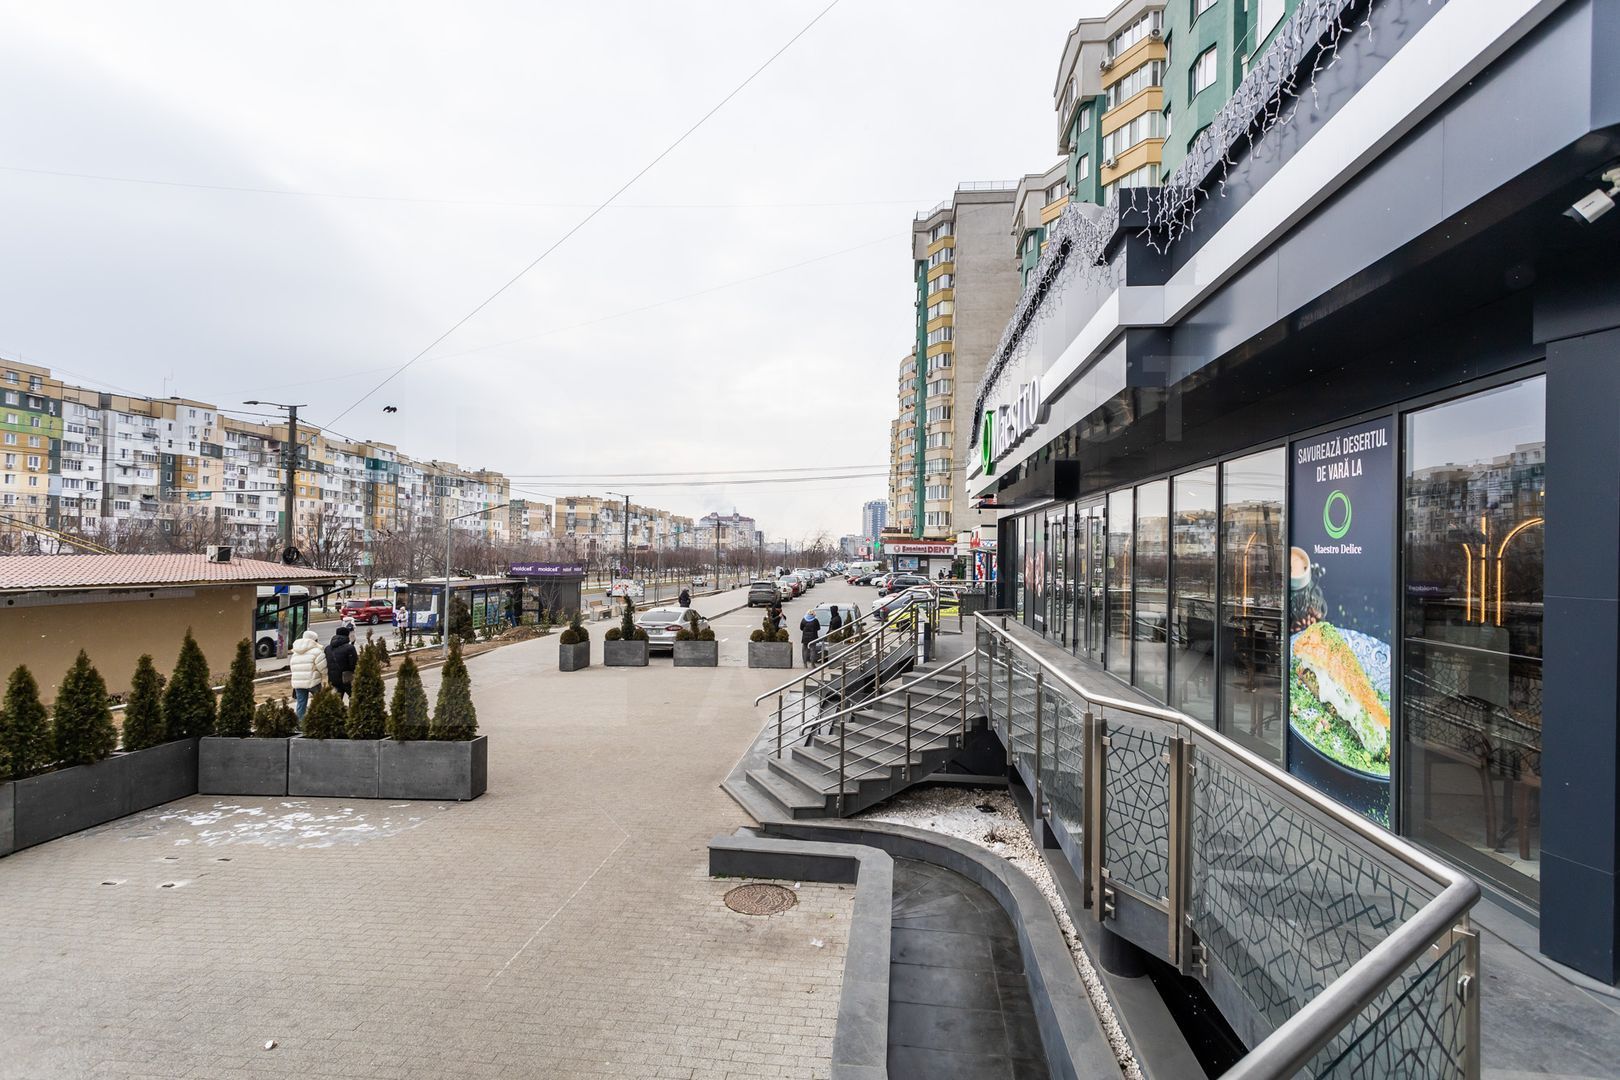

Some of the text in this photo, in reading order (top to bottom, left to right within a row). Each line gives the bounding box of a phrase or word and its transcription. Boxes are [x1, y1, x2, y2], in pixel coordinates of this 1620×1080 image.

[990, 375, 1040, 463] Maestro
[1298, 428, 1388, 464] SAVUREAZĂ DESERTUL
[1316, 458, 1363, 482] DE VARĂ LA
[927, 546, 951, 554] DENT
[1314, 543, 1362, 554] Maestro Delice
